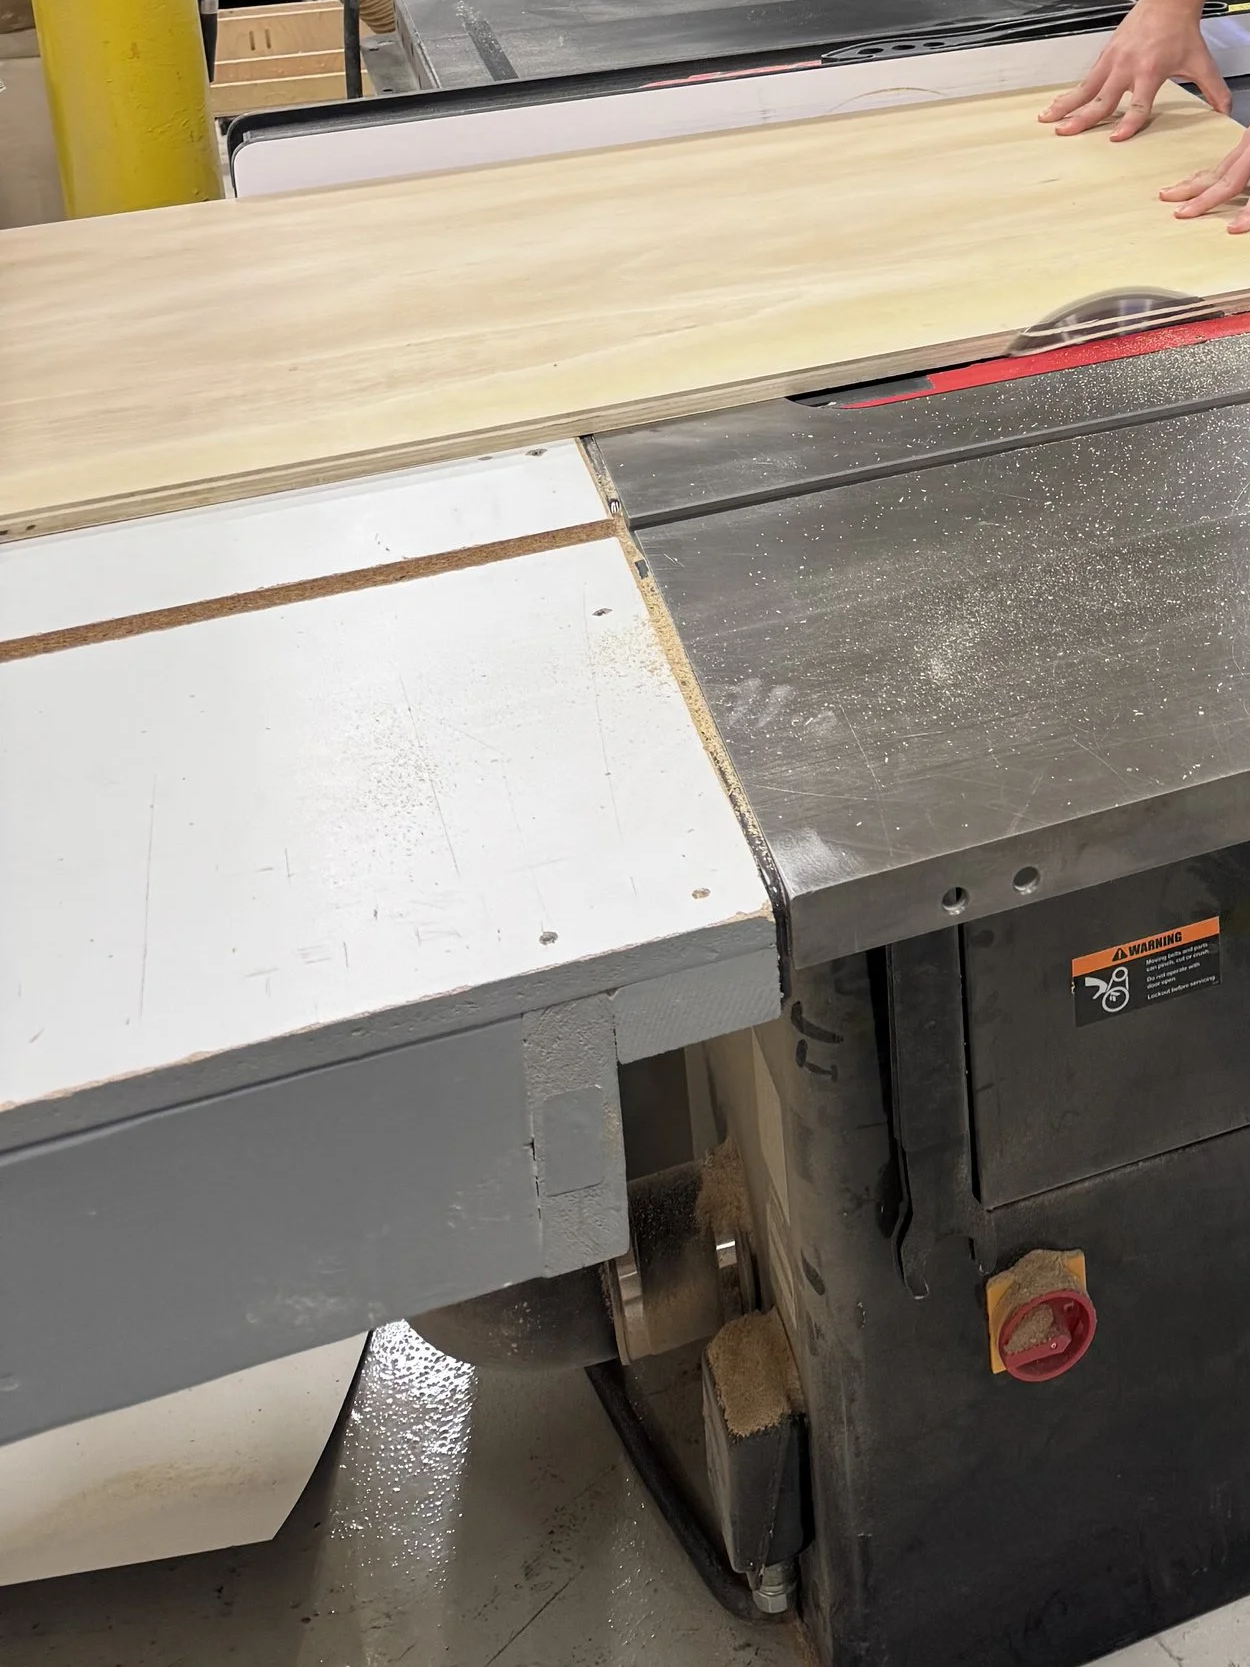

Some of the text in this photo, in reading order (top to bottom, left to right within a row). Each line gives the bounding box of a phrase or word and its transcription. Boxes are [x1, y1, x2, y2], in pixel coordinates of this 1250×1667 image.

[1128, 931, 1182, 956] WARNING
[1182, 946, 1194, 954] and
[1193, 942, 1208, 952] parts
[1166, 966, 1188, 977] operate
[1188, 962, 1201, 970] with
[1147, 975, 1216, 1000] Lockout before servicing
